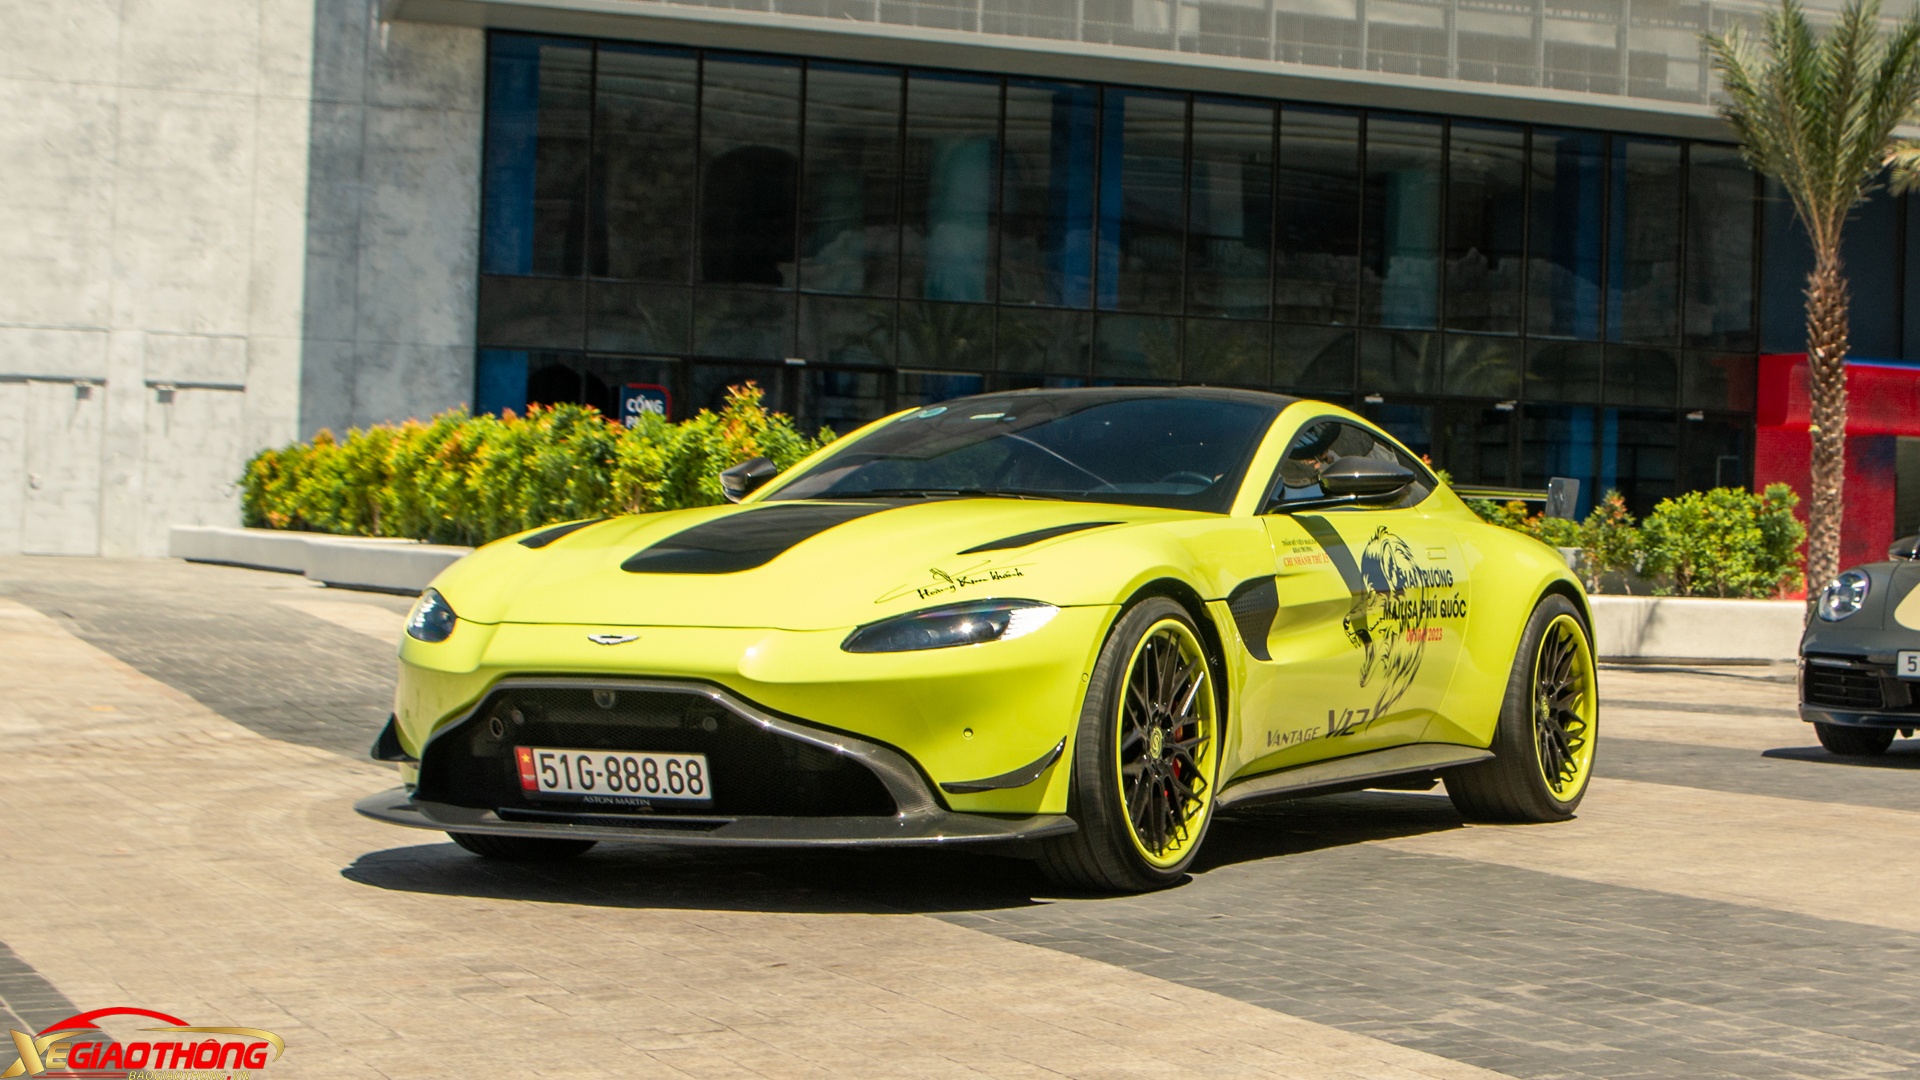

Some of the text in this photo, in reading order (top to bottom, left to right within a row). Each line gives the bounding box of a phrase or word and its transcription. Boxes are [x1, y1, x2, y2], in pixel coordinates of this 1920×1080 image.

[1397, 570, 1419, 589] HAI
[1420, 594, 1438, 619] PHÚ
[1440, 592, 1467, 619] QUỐC
[1325, 708, 1371, 739] V12
[539, 753, 704, 795] 51G-888.68
[583, 796, 651, 806] ASTON MARTIN
